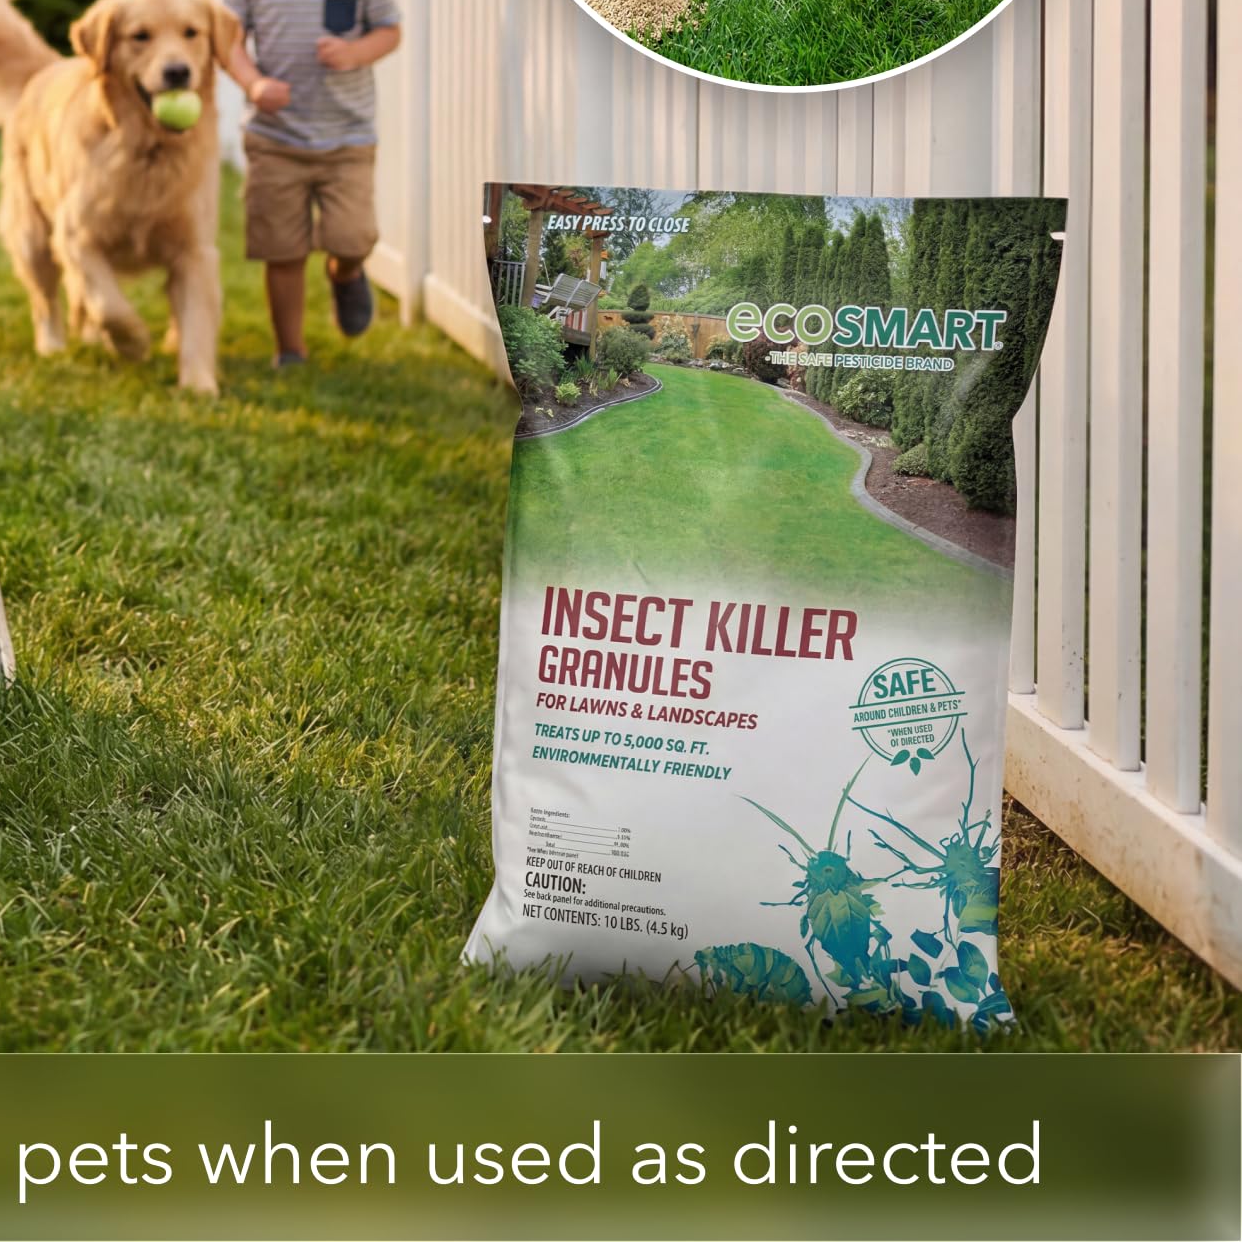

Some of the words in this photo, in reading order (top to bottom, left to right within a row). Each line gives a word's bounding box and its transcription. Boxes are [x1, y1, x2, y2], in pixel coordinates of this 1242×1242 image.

[548, 215, 582, 230] EASY
[582, 215, 625, 231] PRESS
[628, 216, 645, 231] TO
[648, 217, 690, 233] CLOSE
[798, 353, 832, 367] SAFE
[834, 354, 903, 370] PESTICIDE
[906, 355, 954, 371] BRAND
[541, 586, 693, 648] INSECT
[705, 601, 858, 660] KILLER
[538, 645, 713, 700] GRANULES
[873, 668, 936, 699] SAFE
[536, 692, 566, 710] FOR
[569, 696, 627, 718] LAWNS
[630, 703, 642, 719] &
[647, 705, 758, 730] LANDSCAPES
[854, 710, 886, 723] AROUND
[888, 704, 928, 717] CHILDREN
[930, 703, 936, 712] &
[535, 723, 580, 741] TREATS
[582, 729, 600, 742] UP
[604, 731, 622, 746] TO
[623, 734, 663, 750] 5,000
[666, 738, 687, 753] SQ.
[690, 741, 710, 755] FT.
[901, 734, 934, 746] DIRECTED
[915, 724, 932, 733] USED
[663, 761, 732, 781] FRIENDLY
[525, 871, 586, 895] CAUTION:
[526, 856, 546, 868] KEEP
[547, 858, 563, 871] OUT
[565, 861, 576, 872] OF
[577, 863, 604, 876] REACH
[606, 867, 617, 878] OF
[619, 868, 661, 883] CHILDREN
[524, 889, 535, 899] See
[537, 890, 551, 901] back
[552, 892, 572, 905] panel
[573, 895, 583, 907] for
[584, 897, 620, 911] additional
[622, 903, 666, 916] precautions.
[523, 904, 542, 919] NET
[544, 907, 601, 927] CONTENTS:
[605, 916, 617, 929] 10
[620, 918, 643, 932] LBS.
[646, 919, 667, 936] (4.5
[671, 923, 689, 940] kg)
